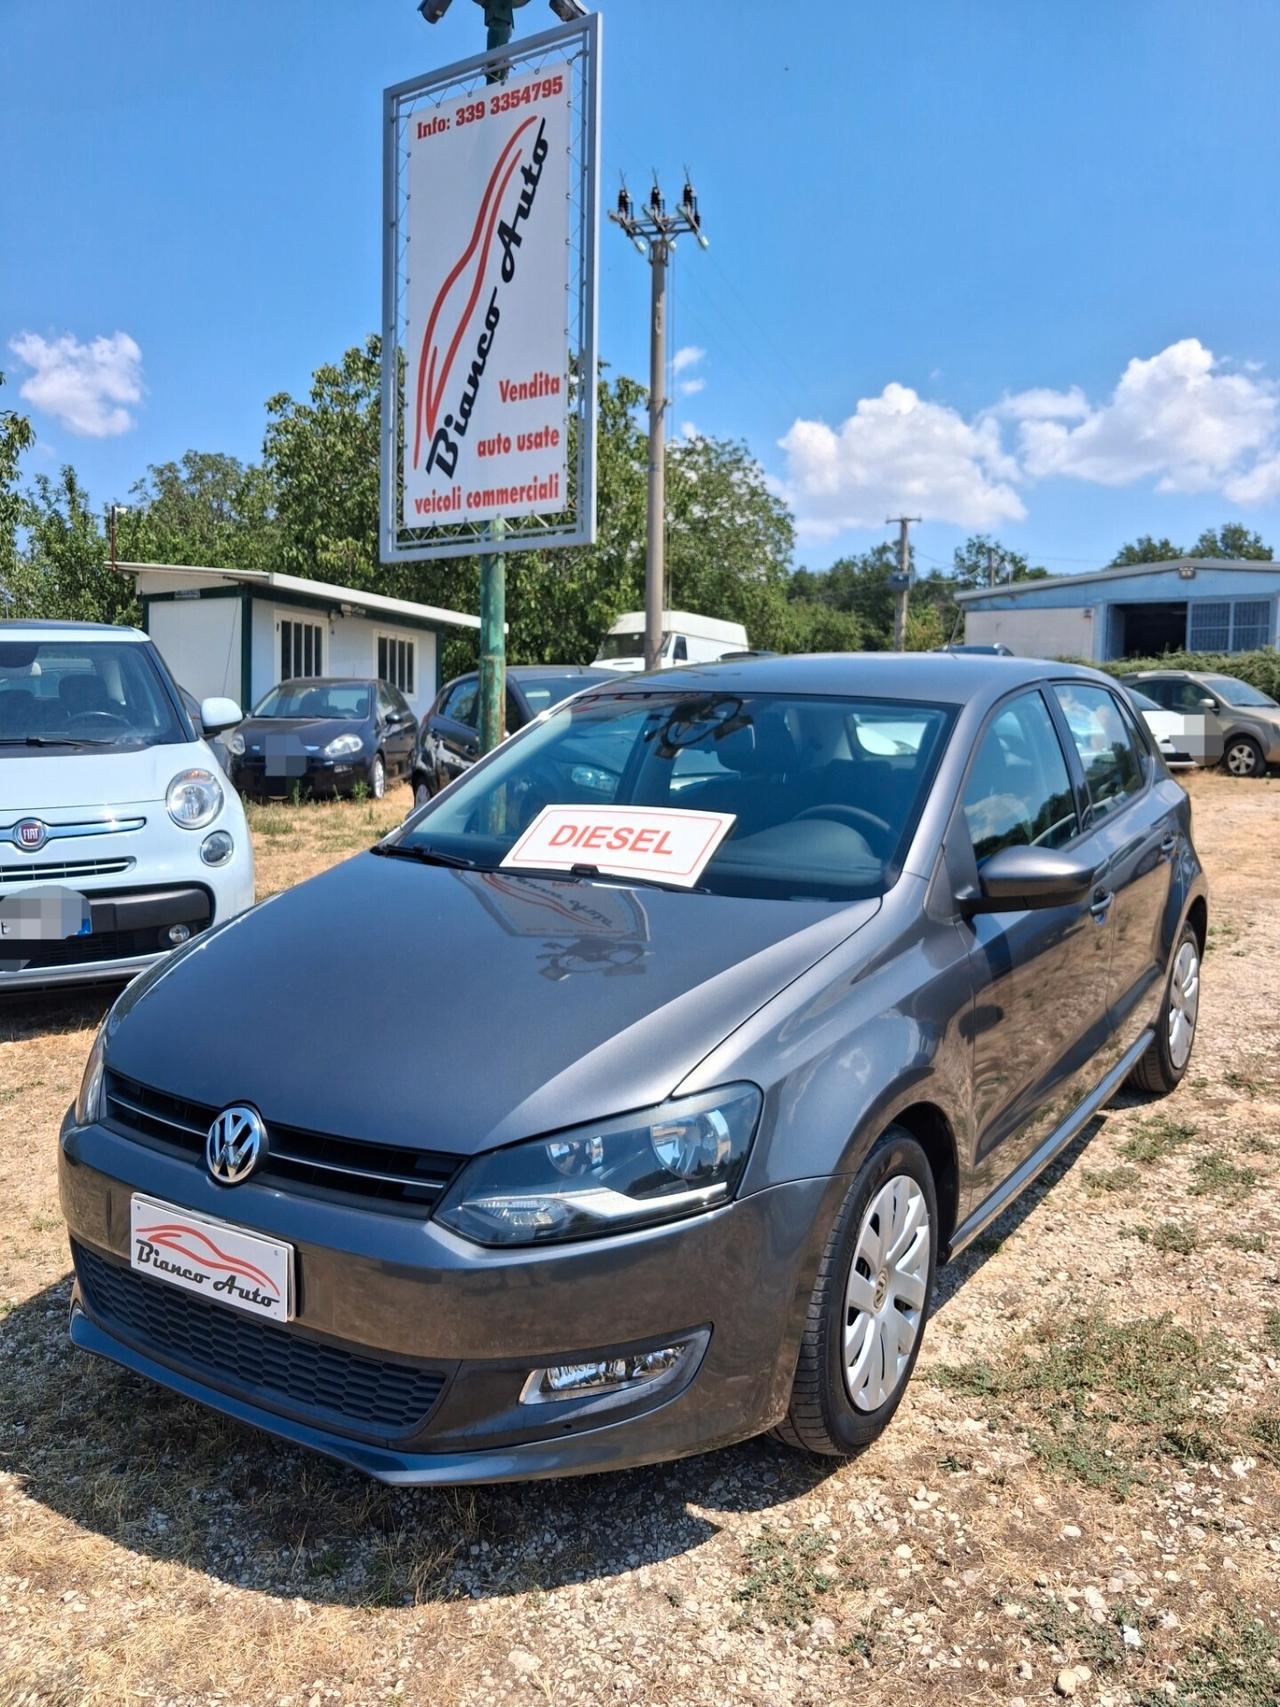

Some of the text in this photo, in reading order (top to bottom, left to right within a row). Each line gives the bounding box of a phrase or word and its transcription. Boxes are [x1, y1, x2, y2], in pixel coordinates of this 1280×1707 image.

[417, 75, 563, 139] Info: 339 3354795
[425, 117, 548, 479] Bianco Auto
[499, 371, 560, 403] Vendita
[477, 425, 560, 457] auto usate
[414, 473, 559, 514] veicoli commerciali
[23, 828, 39, 840] FIAT
[548, 825, 673, 855] DIESEL
[136, 1238, 280, 1308] Bianco Auto
